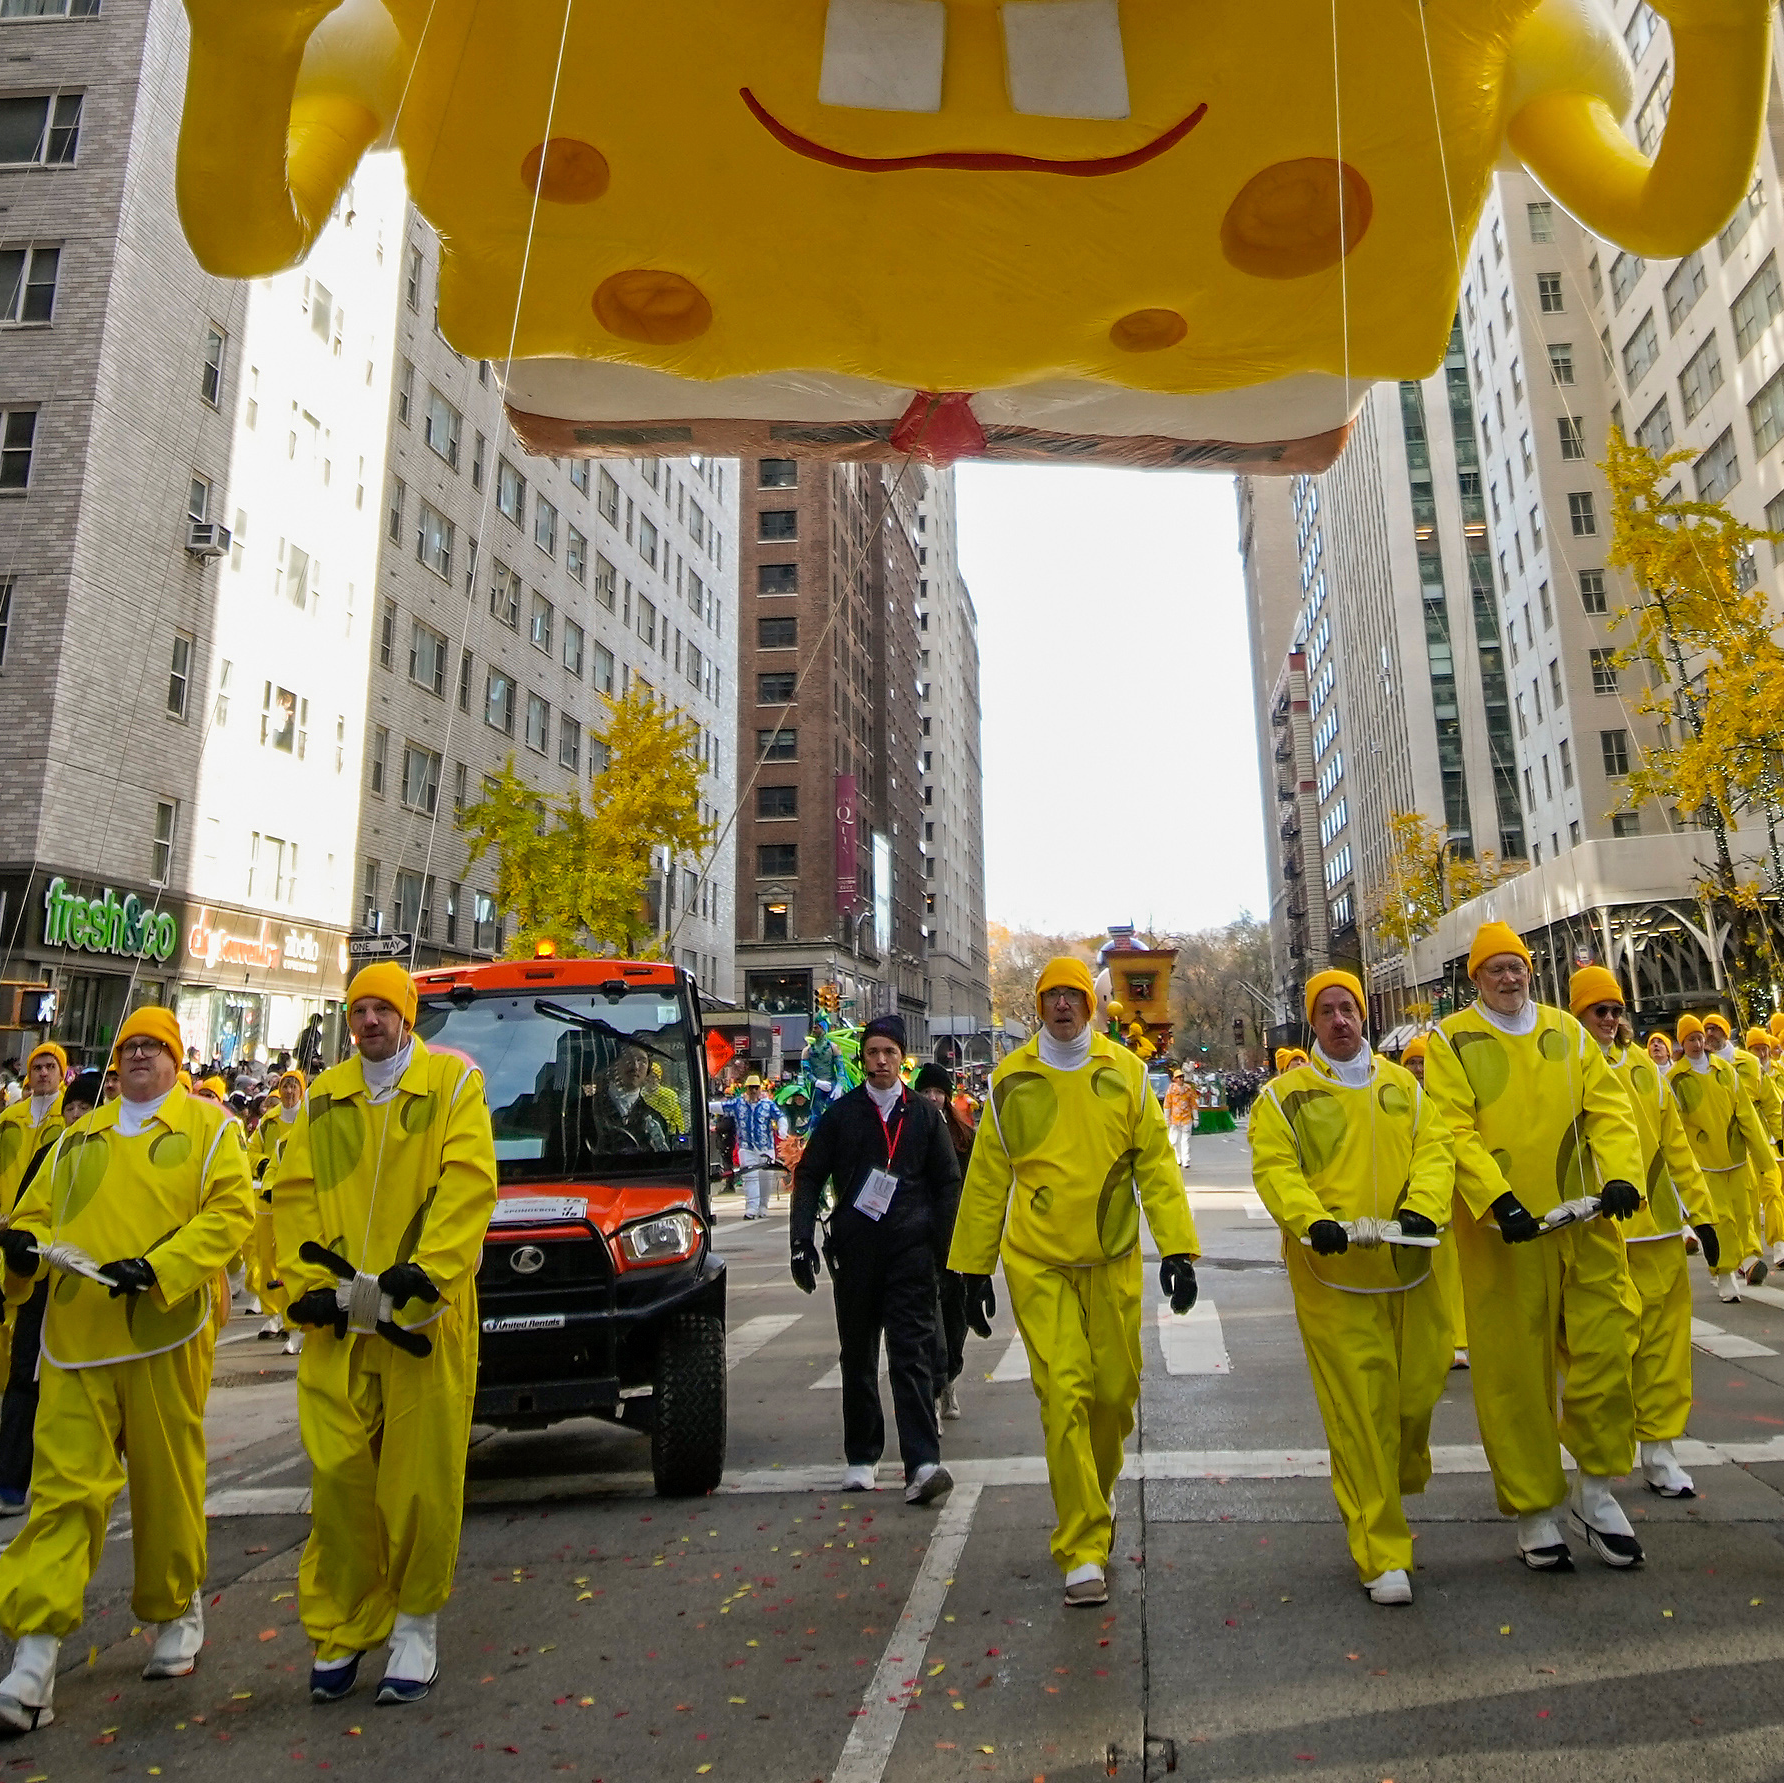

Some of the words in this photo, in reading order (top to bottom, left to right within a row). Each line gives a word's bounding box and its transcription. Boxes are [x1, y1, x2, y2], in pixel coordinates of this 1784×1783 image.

[44, 877, 177, 962] fresh&co
[352, 942, 371, 952] ONE
[382, 940, 401, 950] WAY
[498, 1319, 527, 1330] United
[528, 1317, 560, 1328] Rentals
